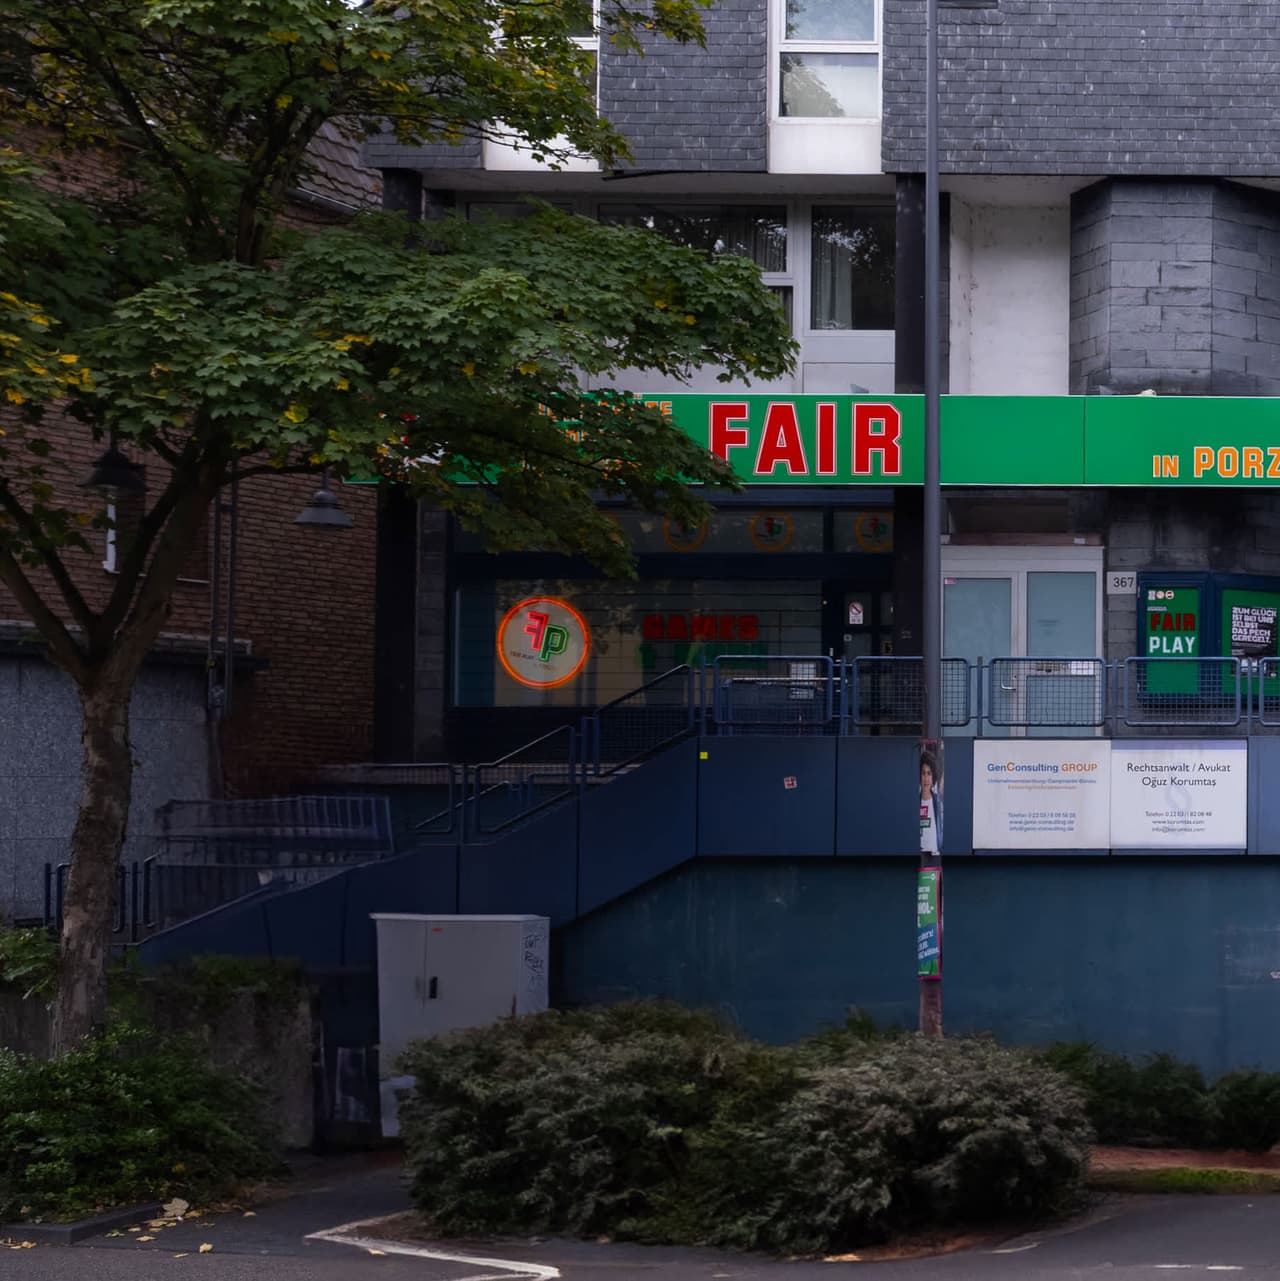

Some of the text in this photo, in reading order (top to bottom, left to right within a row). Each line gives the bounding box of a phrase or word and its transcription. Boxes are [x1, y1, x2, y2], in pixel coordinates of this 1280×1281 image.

[708, 400, 903, 477] FAIR
[1153, 455, 1179, 478] IN
[1113, 577, 1134, 588] 367
[1251, 607, 1277, 617] GLÜCK
[1150, 613, 1196, 632] FAIR
[1249, 629, 1270, 637] PECH
[1149, 636, 1196, 654] PLAY
[987, 762, 1098, 773] GenConsulting GROUP
[1127, 762, 1189, 773] Rechtsanwalt
[1198, 763, 1231, 772] Avukat
